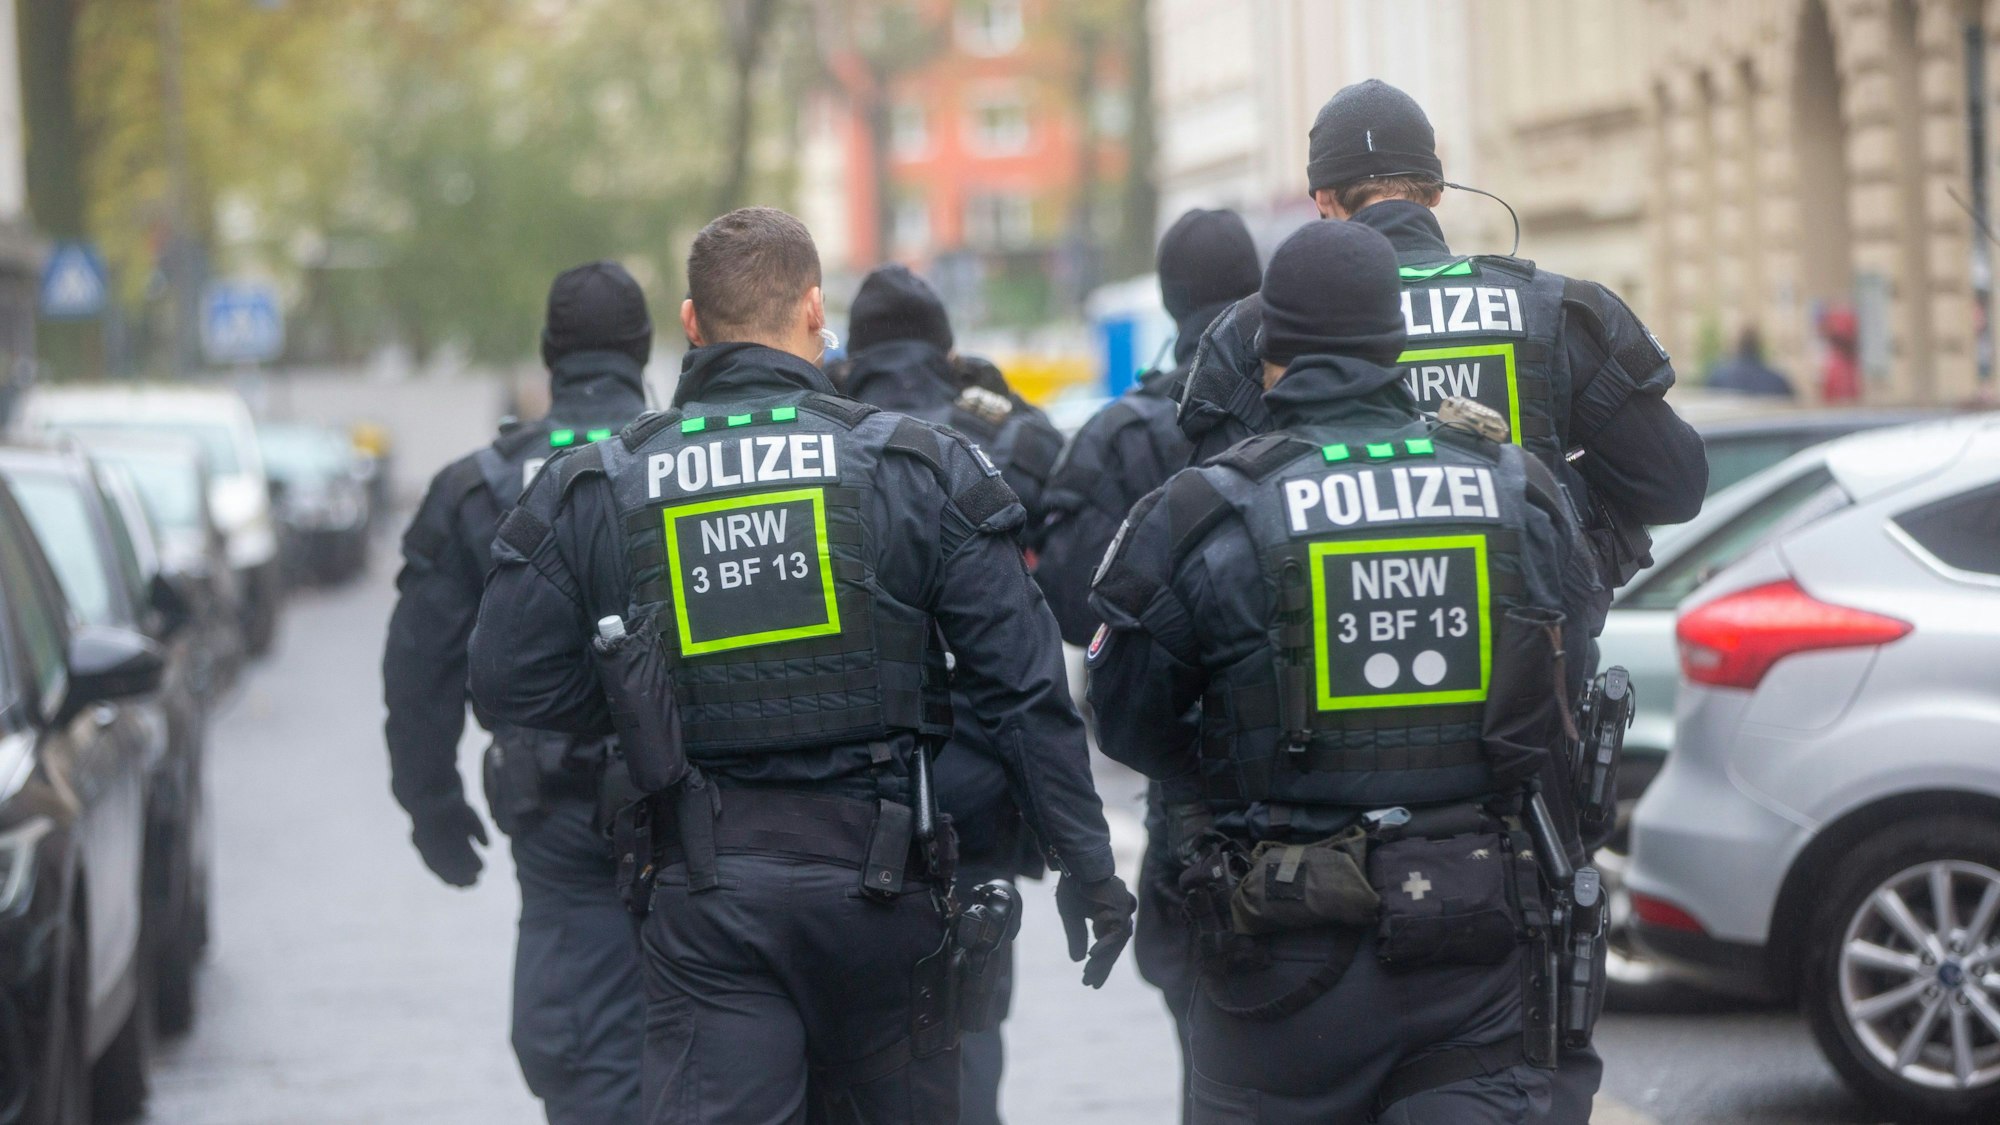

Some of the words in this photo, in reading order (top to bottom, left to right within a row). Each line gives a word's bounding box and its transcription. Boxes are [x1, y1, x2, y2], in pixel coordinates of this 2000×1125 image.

[1400, 287, 1523, 336] LIZEI
[648, 434, 837, 498] POLIZEI
[1285, 466, 1499, 531] POLIZEI
[701, 509, 787, 555] NRW
[692, 566, 711, 593] 3
[719, 557, 761, 589] BF
[772, 552, 809, 580] 13
[1352, 556, 1449, 600] NRW
[1338, 613, 1358, 643] 3
[1370, 609, 1418, 641] BF
[1429, 607, 1469, 637] 13
